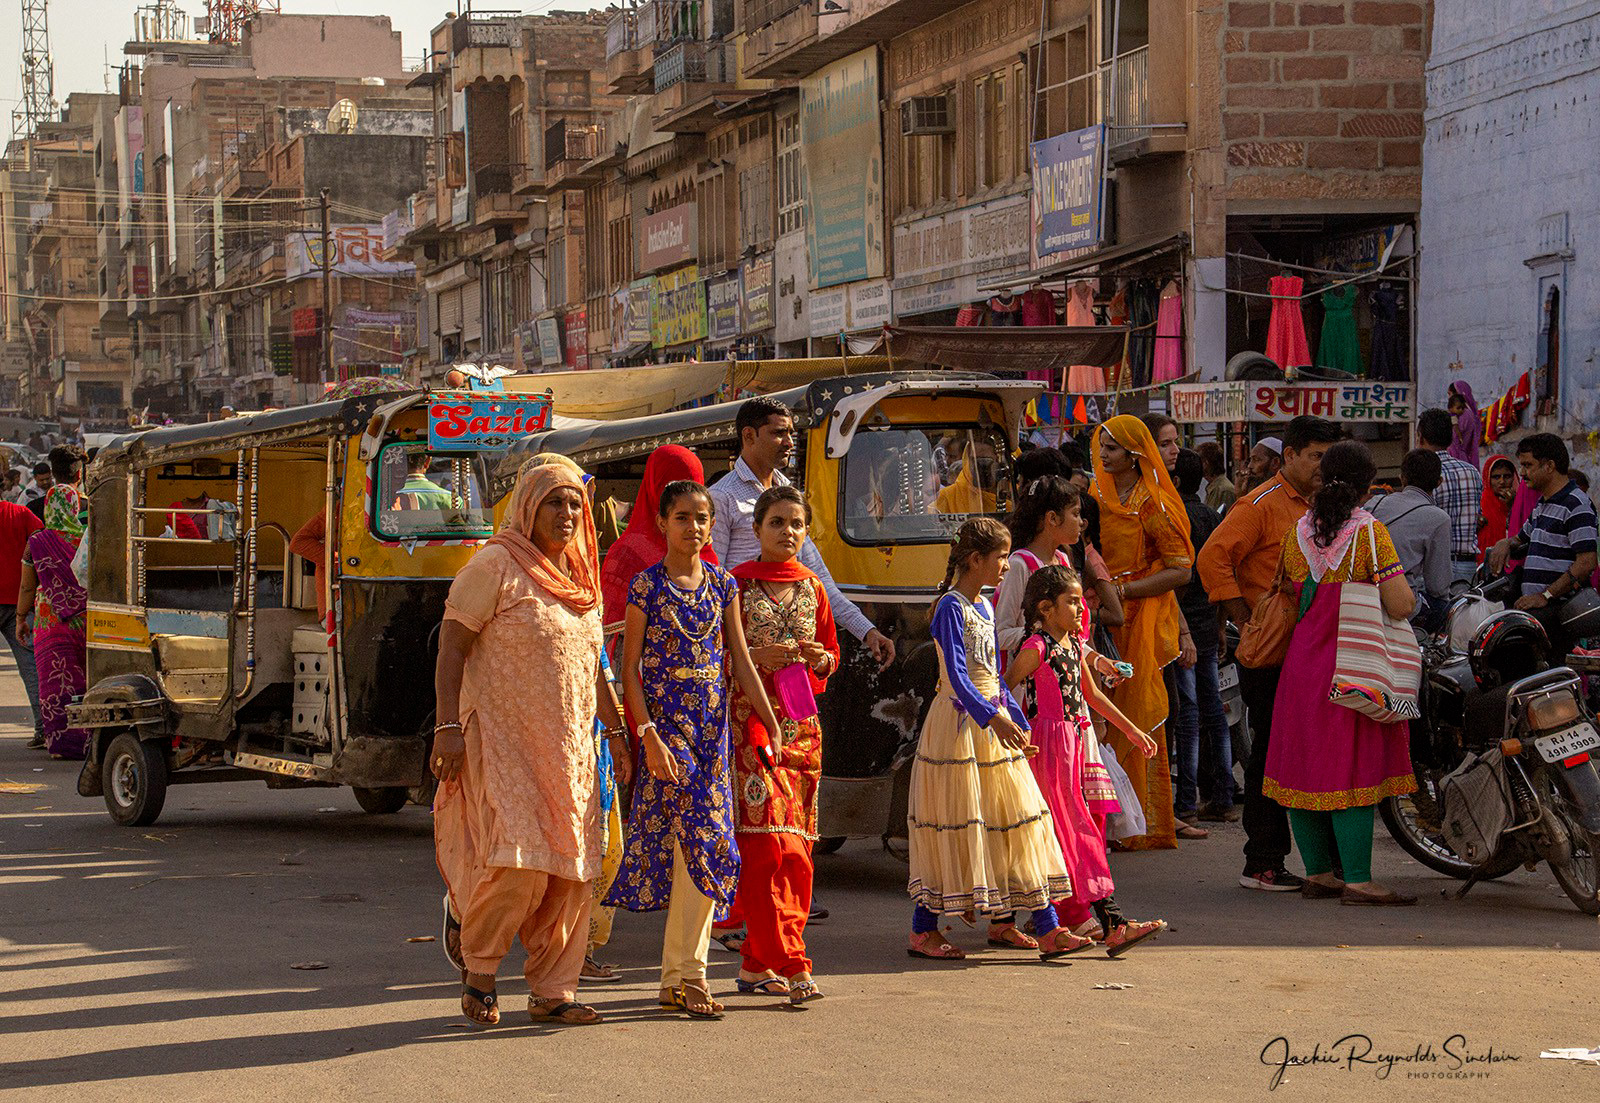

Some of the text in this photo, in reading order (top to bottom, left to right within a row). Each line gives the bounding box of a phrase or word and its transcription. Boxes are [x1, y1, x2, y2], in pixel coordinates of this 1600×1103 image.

[669, 215, 684, 248] Bank
[1255, 386, 1339, 419] श्याम
[1342, 384, 1410, 402] नाश्ता
[1341, 401, 1410, 420] कॉर्नर
[431, 404, 549, 439] Sazid
[1550, 730, 1579, 746] RJ 14
[1570, 736, 1596, 751] 5909
